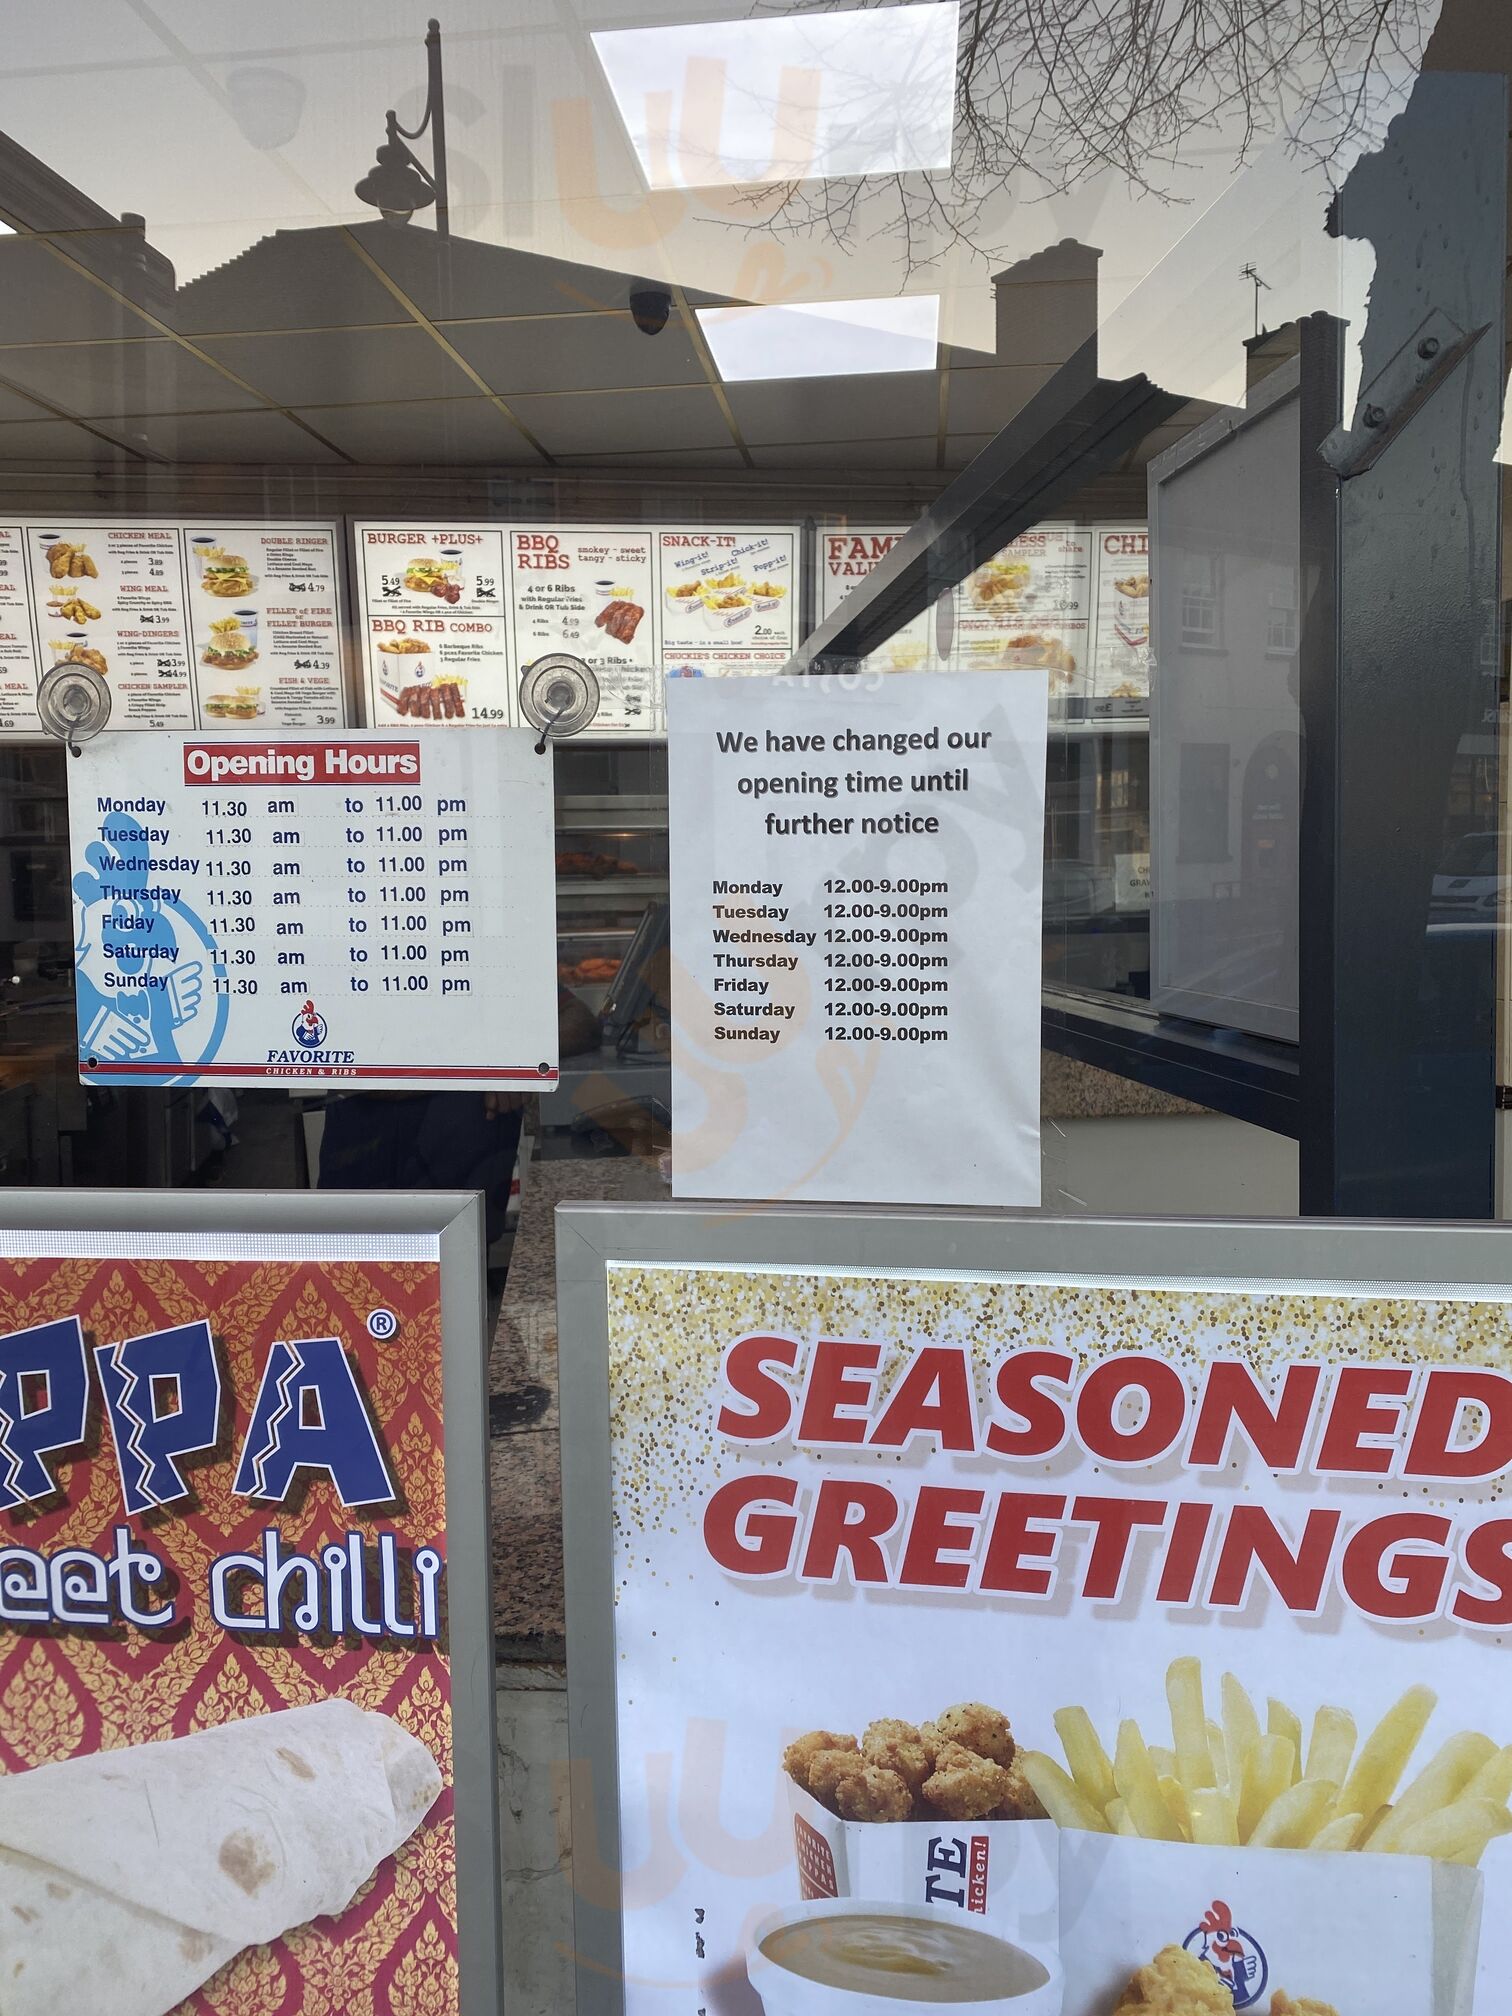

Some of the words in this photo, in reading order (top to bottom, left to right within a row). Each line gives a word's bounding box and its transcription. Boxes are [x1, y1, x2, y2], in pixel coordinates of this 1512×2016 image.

[368, 533, 426, 544] BURGER
[432, 534, 484, 544] +PLUS+
[517, 534, 559, 554] BBQ
[662, 536, 736, 548] SNACK-IT!
[731, 538, 769, 557] Chick-it!
[578, 546, 610, 554] smokey
[828, 536, 905, 560] FAM
[518, 554, 570, 569] RIBS
[578, 555, 606, 563] tangy
[616, 555, 647, 563] sticky
[674, 551, 709, 568] Wing-it!
[700, 557, 738, 576] Strip-it!
[753, 554, 787, 572] Popp-it!
[308, 582, 325, 592] 4.79
[382, 575, 400, 586] 5.49
[476, 576, 494, 586] 5.99
[547, 584, 553, 592] 6
[156, 615, 170, 624] 3.99
[372, 620, 406, 634] BBQ
[413, 620, 445, 632] RIB
[450, 622, 492, 632] COMBO
[754, 624, 772, 636] 2.00
[313, 660, 330, 670] 4.39
[607, 656, 627, 664] Ribs
[316, 714, 335, 724] 3.99
[472, 707, 504, 720] 14.99
[150, 720, 164, 728] 5.49
[716, 731, 758, 752] We
[765, 730, 826, 752] have
[832, 727, 940, 755] changed
[946, 730, 992, 749] our
[187, 750, 314, 782] Opening
[326, 749, 417, 774] Hours
[737, 771, 838, 798] opening
[845, 770, 903, 793] time
[911, 769, 969, 792] until
[97, 797, 166, 816] Monday
[202, 800, 248, 818] 11.30
[268, 799, 294, 814] am
[345, 798, 364, 814] to
[376, 796, 422, 812] 11.00
[438, 798, 466, 816] pm
[764, 812, 855, 836] further
[862, 812, 940, 834] notice
[98, 827, 170, 846] Tuesday
[206, 828, 252, 845] 11.30
[272, 830, 300, 844] am
[346, 828, 364, 844] to
[376, 826, 422, 843] 11.00
[438, 828, 468, 846] pm
[99, 856, 200, 875] Wednesday
[206, 860, 252, 876] 11.30
[272, 862, 300, 876] am
[348, 858, 366, 874] to
[378, 856, 424, 873] 11.00
[438, 858, 468, 876] pm
[100, 885, 182, 904] Thursday
[207, 890, 252, 906] 11.30
[273, 891, 300, 905] am
[348, 888, 366, 904] to
[380, 886, 426, 903] 11.00
[440, 888, 470, 906] pm
[712, 880, 783, 898] Monday
[823, 880, 948, 896] 12.00-9.00pm
[712, 904, 789, 922] Tuesday
[823, 904, 948, 921] 12.00-9.00pm
[102, 914, 155, 933] Friday
[210, 918, 256, 934] 11.30
[276, 921, 304, 935] am
[348, 918, 367, 934] to
[380, 916, 427, 932] 11.00
[442, 919, 472, 937] pm
[713, 929, 816, 946] Wednesday
[823, 928, 948, 946] 12.00-9.00pm
[102, 944, 180, 962] Saturday
[210, 949, 256, 965] 11.30
[277, 950, 305, 964] am
[350, 948, 368, 963] to
[380, 946, 427, 962] 11.00
[441, 948, 470, 966] pm
[713, 954, 798, 971] Thursday
[823, 953, 948, 970] 12.00-9.00pm
[104, 972, 168, 992] Sunday
[212, 979, 258, 996] 11.30
[280, 980, 308, 994] am
[350, 976, 368, 992] to
[382, 976, 428, 992] 11.00
[442, 978, 470, 995] pm
[714, 978, 769, 996] Friday
[823, 978, 948, 995] 12.00-9.00pm
[714, 1002, 796, 1020] Saturday
[823, 1002, 948, 1020] 12.00-9.00pm
[714, 1027, 780, 1044] Sunday
[823, 1026, 948, 1044] 12.00-9.00pm
[266, 1050, 355, 1064] FAVORITE
[266, 1068, 313, 1076] CHICKEN
[316, 1068, 326, 1076] &
[331, 1068, 358, 1076] RIBS
[0, 1314, 396, 1516] PPA
[716, 1335, 1512, 1478] SEASONED
[703, 1474, 1512, 1627] GREETINGS
[209, 1525, 441, 1639] chilli
[926, 1836, 968, 1909] TE
